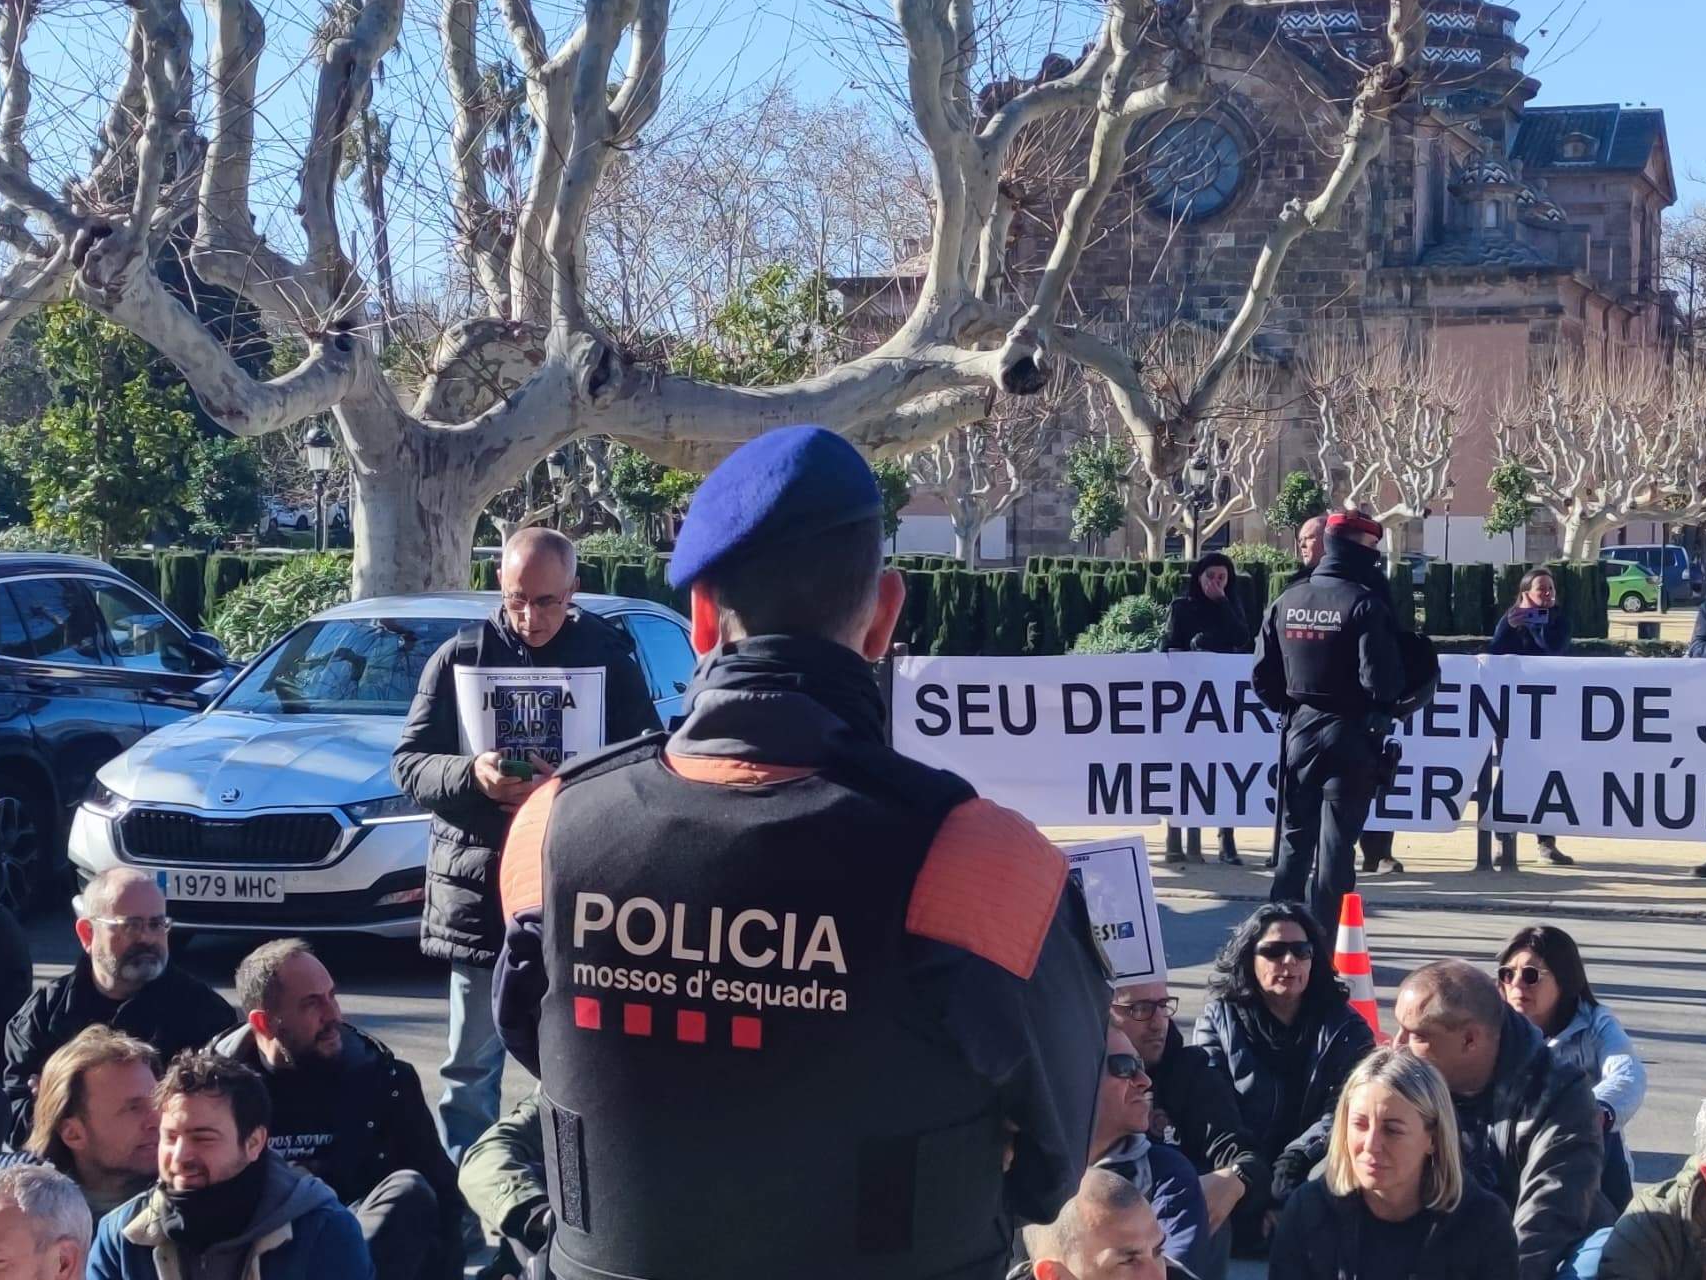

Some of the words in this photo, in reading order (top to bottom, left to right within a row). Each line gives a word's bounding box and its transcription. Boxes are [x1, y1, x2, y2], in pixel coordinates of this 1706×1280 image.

[1286, 608, 1342, 624] POLICIA
[482, 691, 577, 712] JUSTICIA
[914, 683, 1037, 737] SEU
[1580, 685, 1673, 744] DE
[497, 721, 562, 738] PARA
[1492, 768, 1580, 827] LA
[174, 875, 227, 897] 1979
[234, 876, 277, 898] MHC
[573, 891, 848, 974] POLICIA
[573, 963, 678, 996] mossos
[685, 969, 847, 1011] d'esquadra
